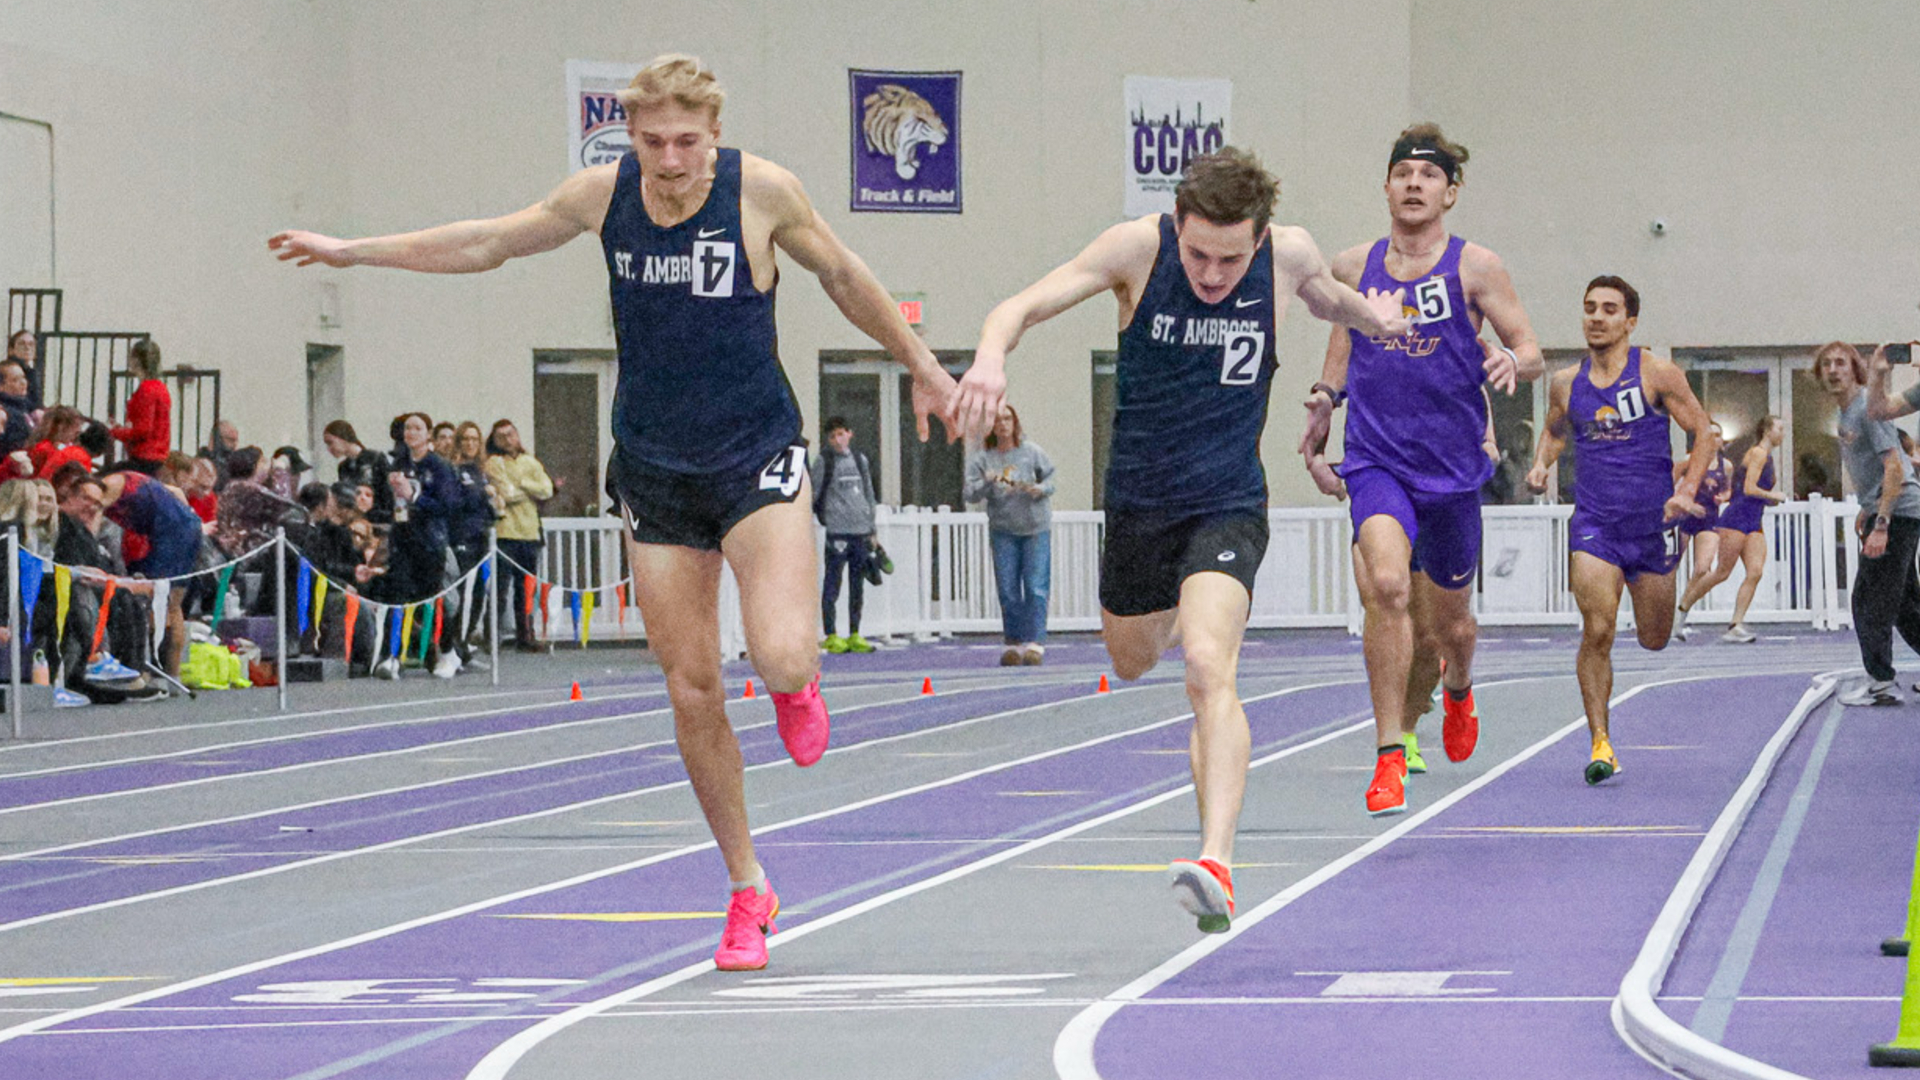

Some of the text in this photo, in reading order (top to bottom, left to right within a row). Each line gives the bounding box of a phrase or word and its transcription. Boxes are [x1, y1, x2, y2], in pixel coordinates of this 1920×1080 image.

[861, 188, 955, 203] Track & Field
[614, 251, 693, 284] ST. AMBR
[699, 245, 730, 293] 4
[1420, 283, 1445, 319] 5
[1151, 313, 1176, 344] ST.
[1226, 335, 1258, 381] 2
[1621, 390, 1637, 418] 1
[765, 449, 796, 484] 4
